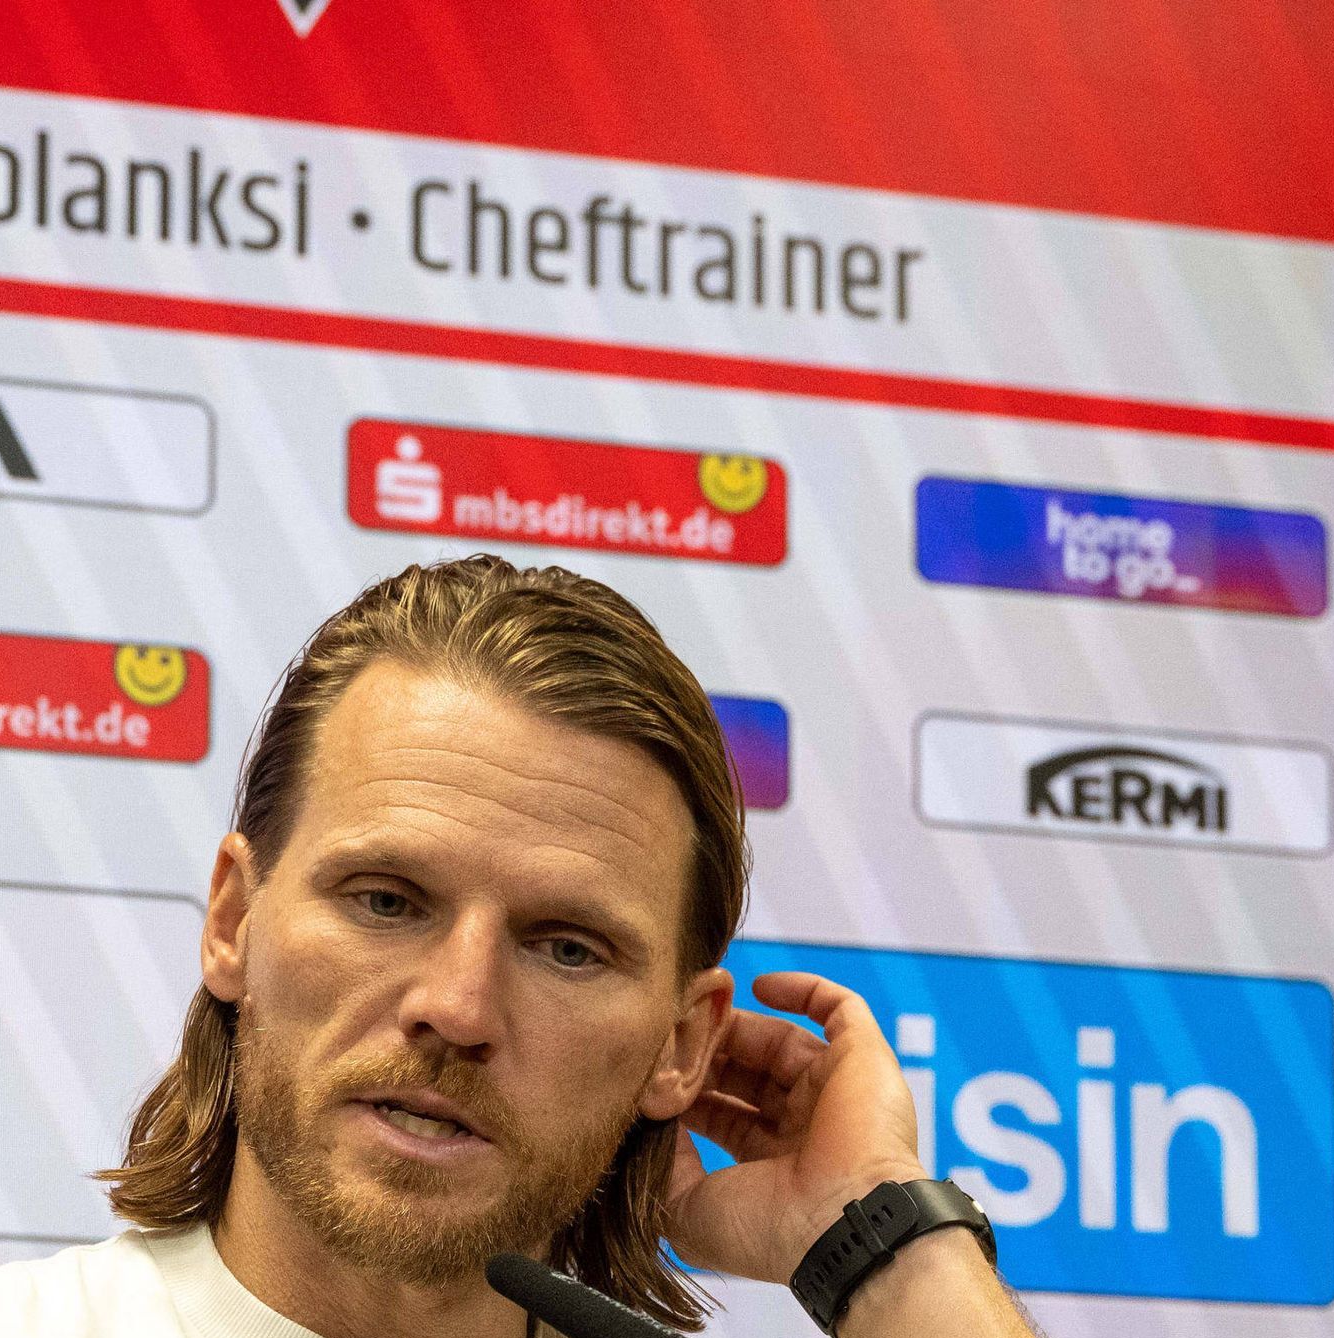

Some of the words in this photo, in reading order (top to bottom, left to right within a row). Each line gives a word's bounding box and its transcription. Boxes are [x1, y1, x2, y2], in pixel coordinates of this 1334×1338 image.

[408, 179, 926, 324] Cheftrainer
[453, 490, 735, 555] mbsdirekt.de
[1025, 743, 1229, 834] KERMI
